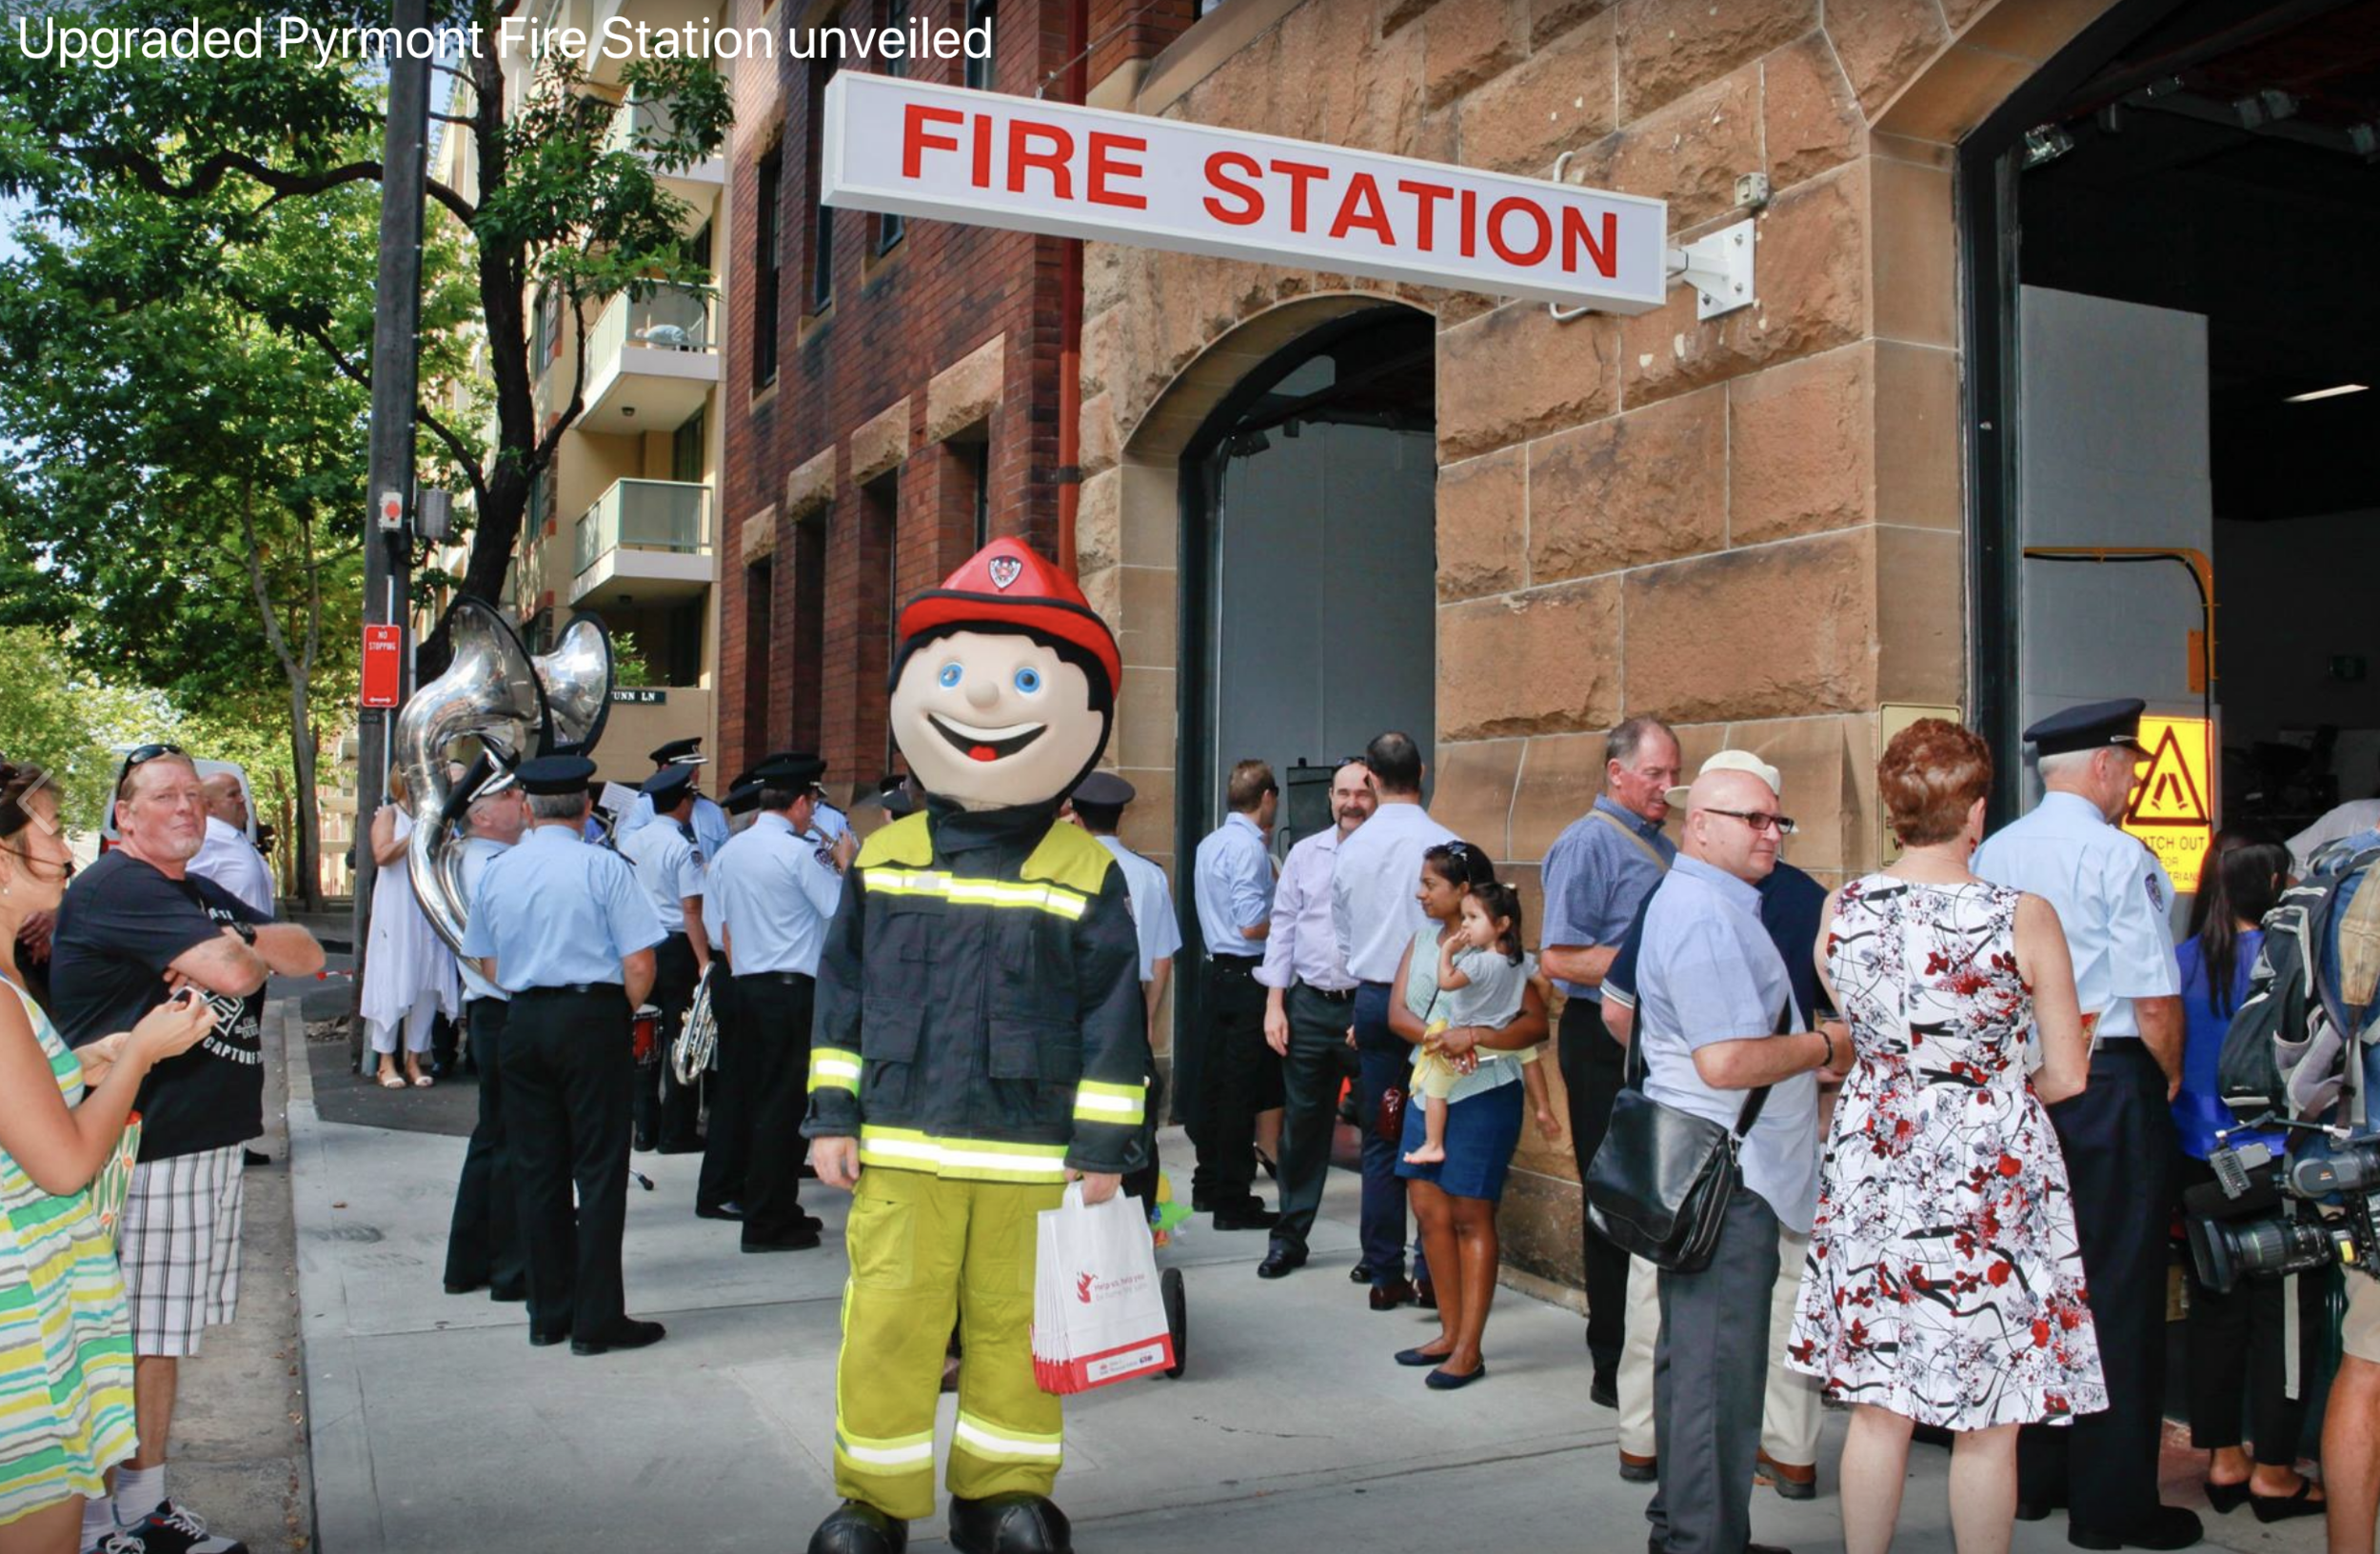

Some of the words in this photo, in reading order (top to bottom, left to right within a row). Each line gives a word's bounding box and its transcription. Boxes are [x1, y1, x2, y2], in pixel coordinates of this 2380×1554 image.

[902, 103, 1148, 210] FIRE
[1202, 150, 1617, 279] STATION
[368, 642, 396, 650] STOPPING
[611, 690, 635, 701] UNN
[641, 691, 655, 701] LN
[2179, 835, 2205, 850] OUT
[203, 1035, 256, 1065] CAPTURE
